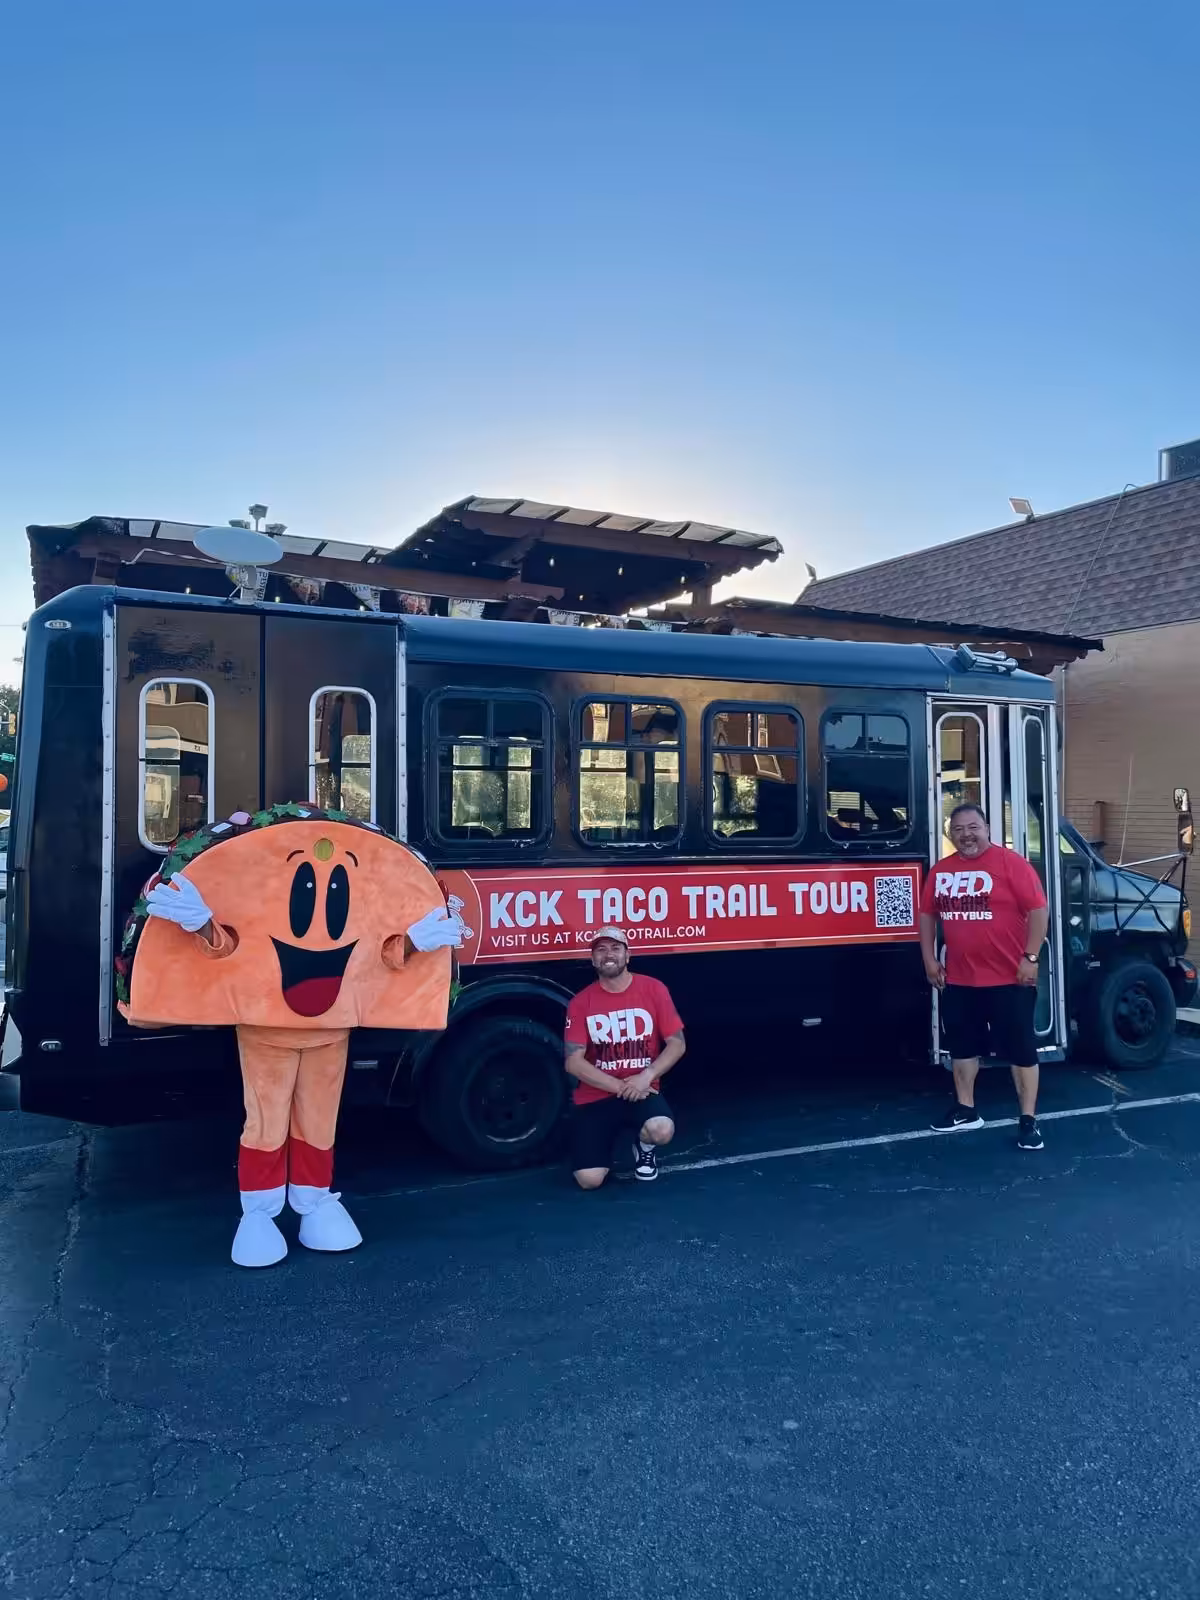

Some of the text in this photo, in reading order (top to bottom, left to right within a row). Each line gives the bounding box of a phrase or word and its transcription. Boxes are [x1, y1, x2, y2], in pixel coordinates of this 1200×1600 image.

[934, 870, 993, 898] RED
[490, 881, 869, 928] KCK TACO TRAIL TOUR
[491, 934, 527, 948] VISIT
[531, 933, 549, 945] US
[553, 931, 571, 944] AT
[586, 1007, 654, 1045] RED
